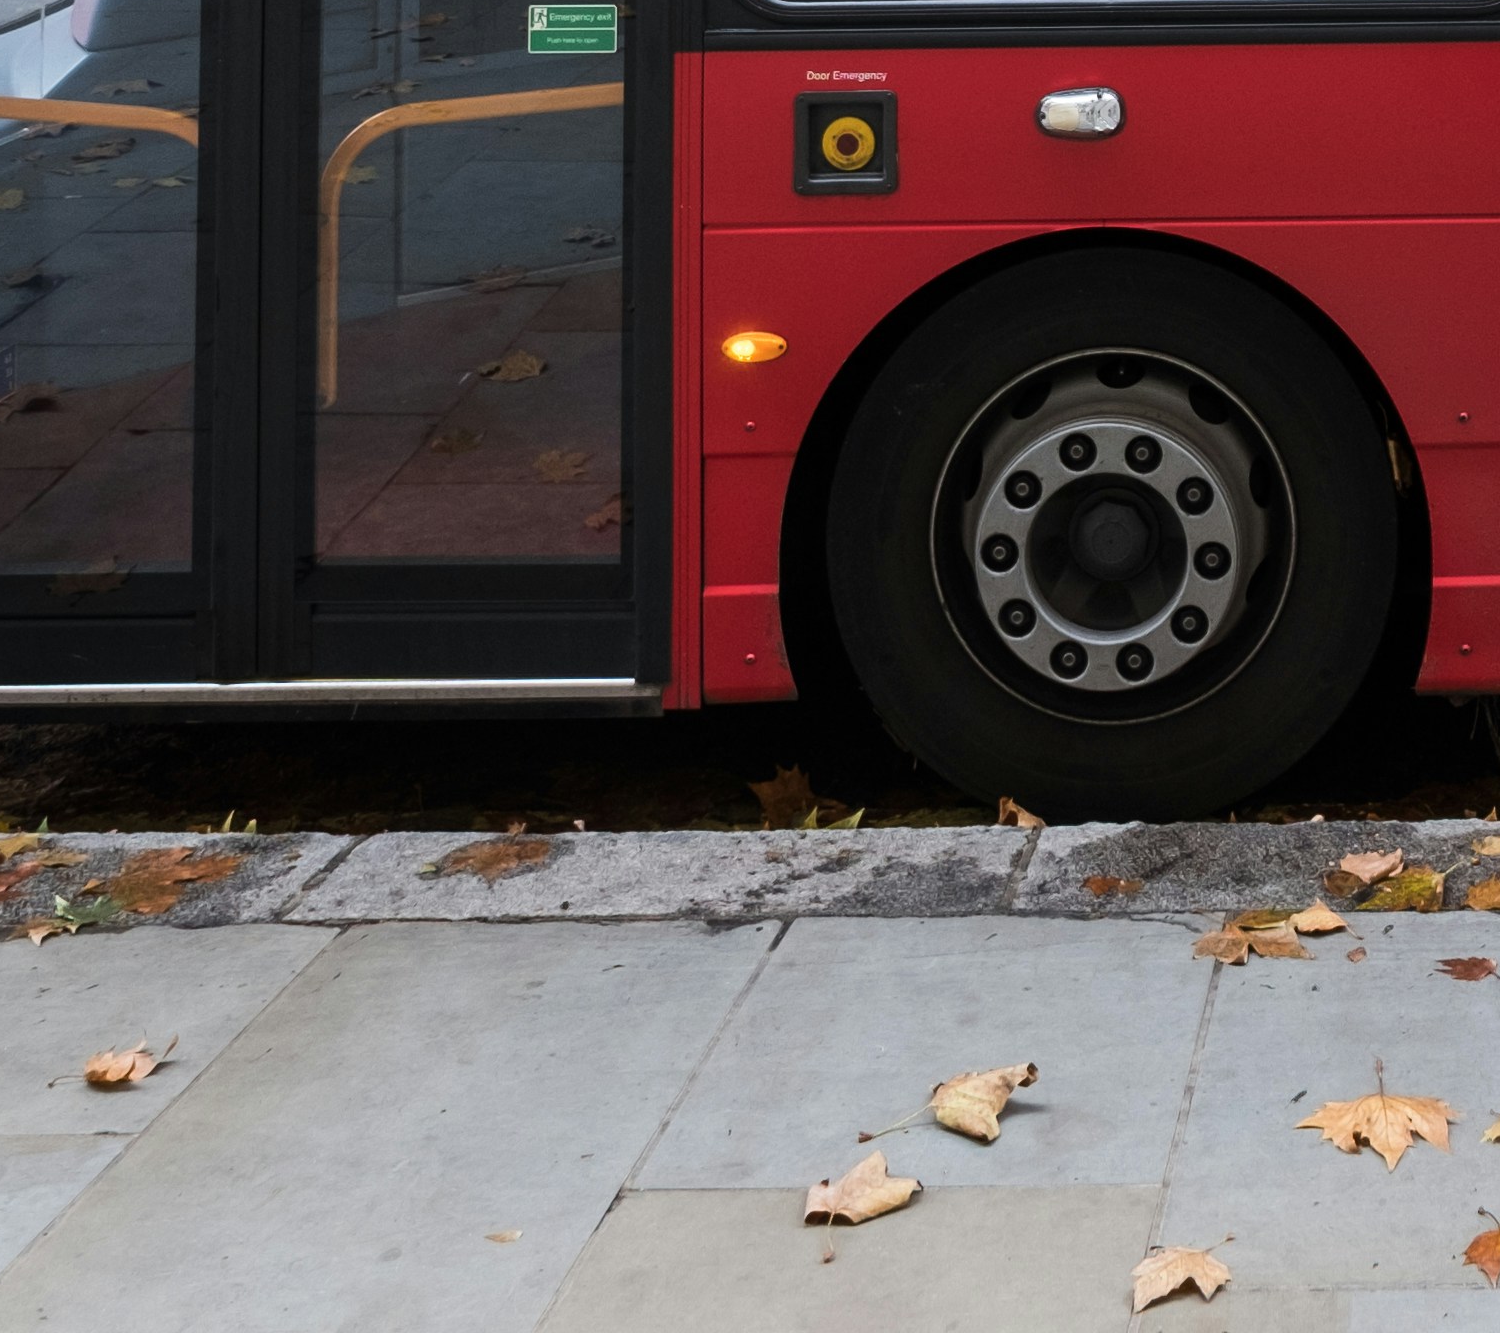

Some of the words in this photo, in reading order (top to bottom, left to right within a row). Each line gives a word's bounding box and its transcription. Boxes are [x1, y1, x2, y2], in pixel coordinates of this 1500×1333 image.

[549, 12, 596, 23] Emergency
[596, 12, 612, 21] exit
[806, 70, 831, 81] Door
[832, 70, 889, 83] Emergency
